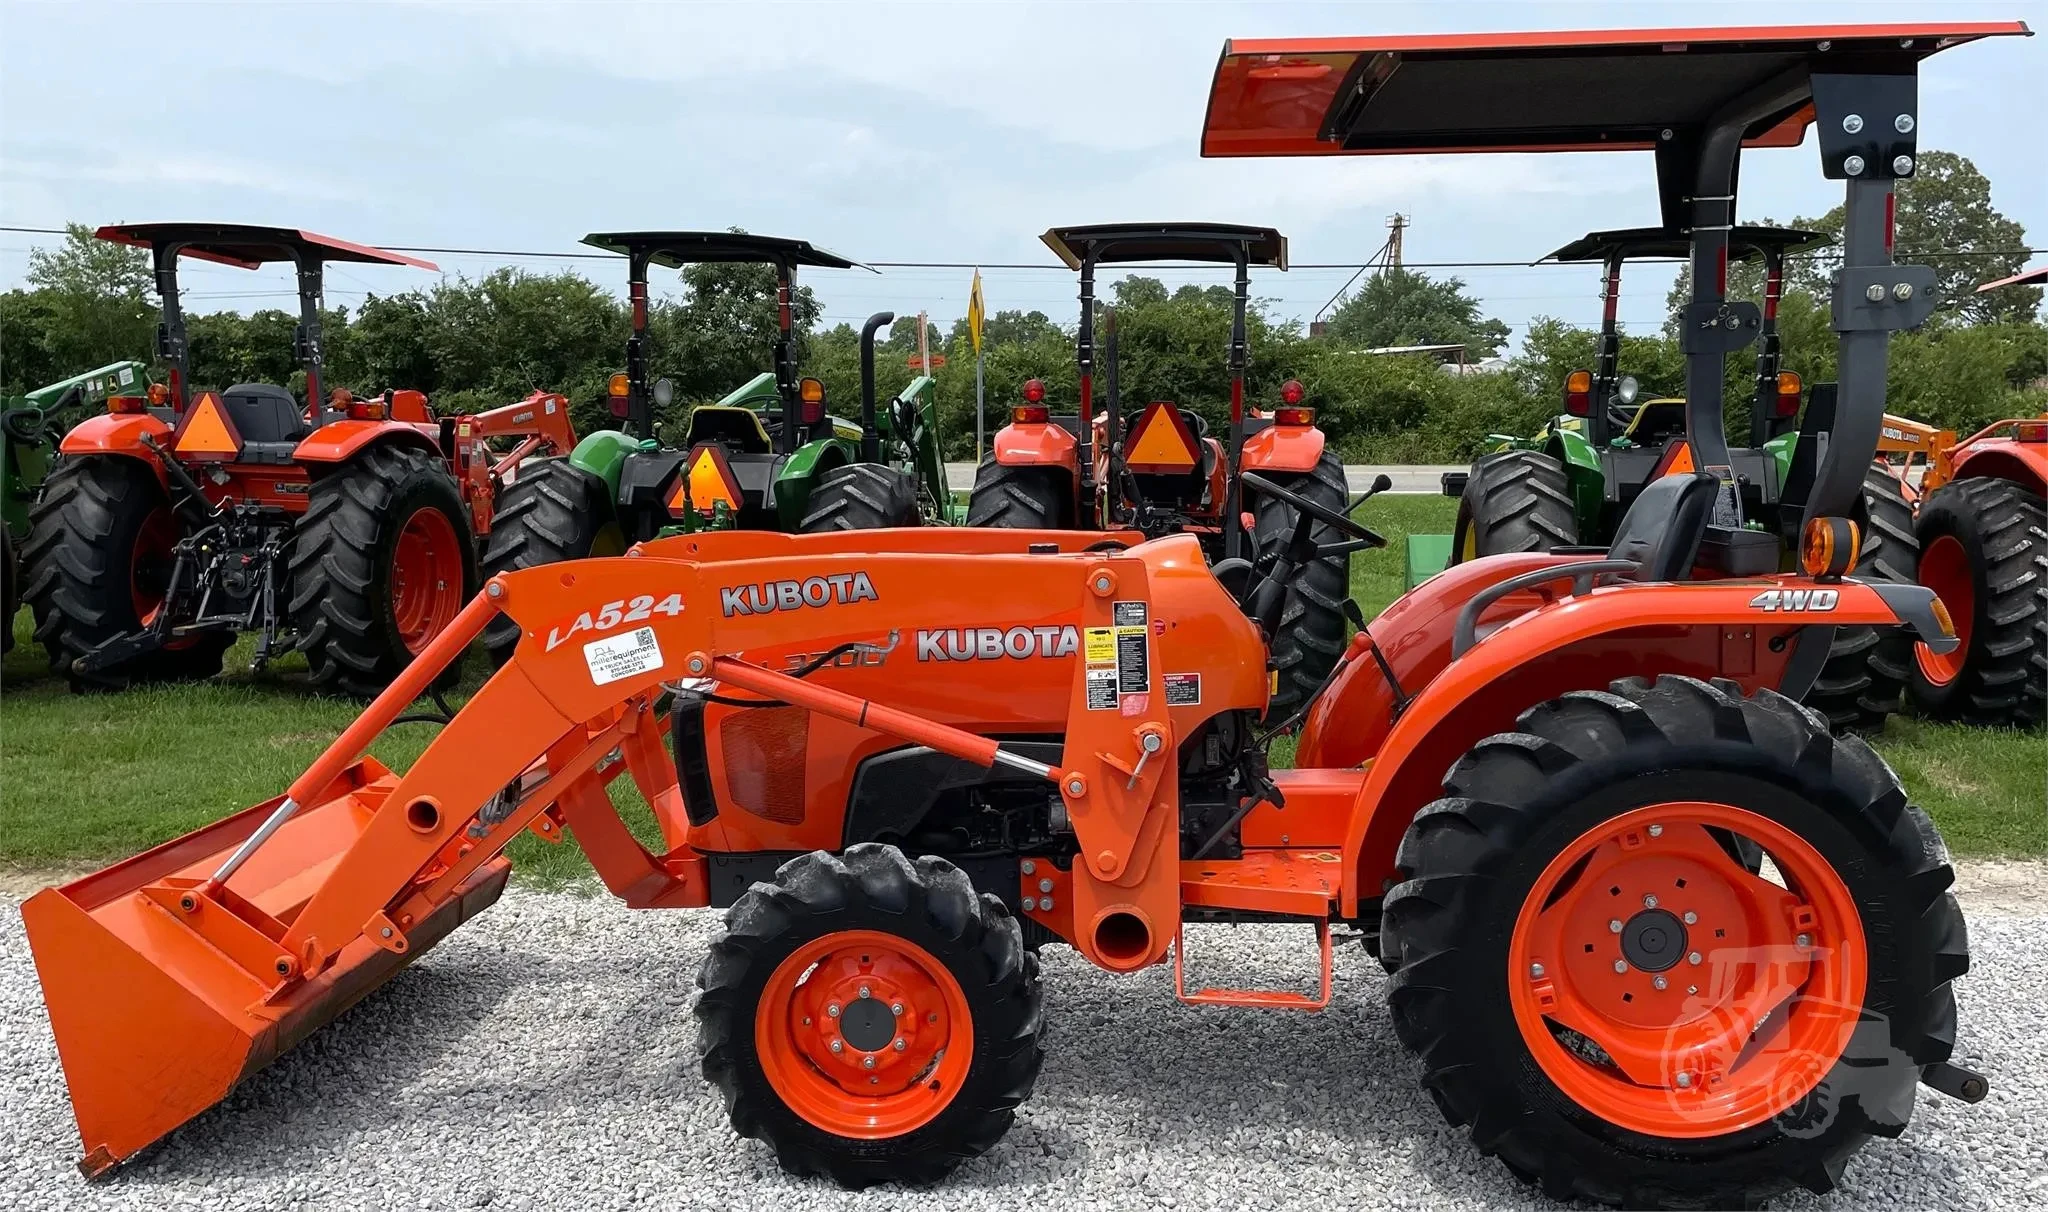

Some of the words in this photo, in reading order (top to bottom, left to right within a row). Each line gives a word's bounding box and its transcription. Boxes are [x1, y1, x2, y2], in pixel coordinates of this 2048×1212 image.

[720, 571, 879, 617] KUBOTA
[1749, 588, 1840, 612] 4WD
[545, 593, 685, 653] LA524
[917, 624, 1080, 662] KUBOTA
